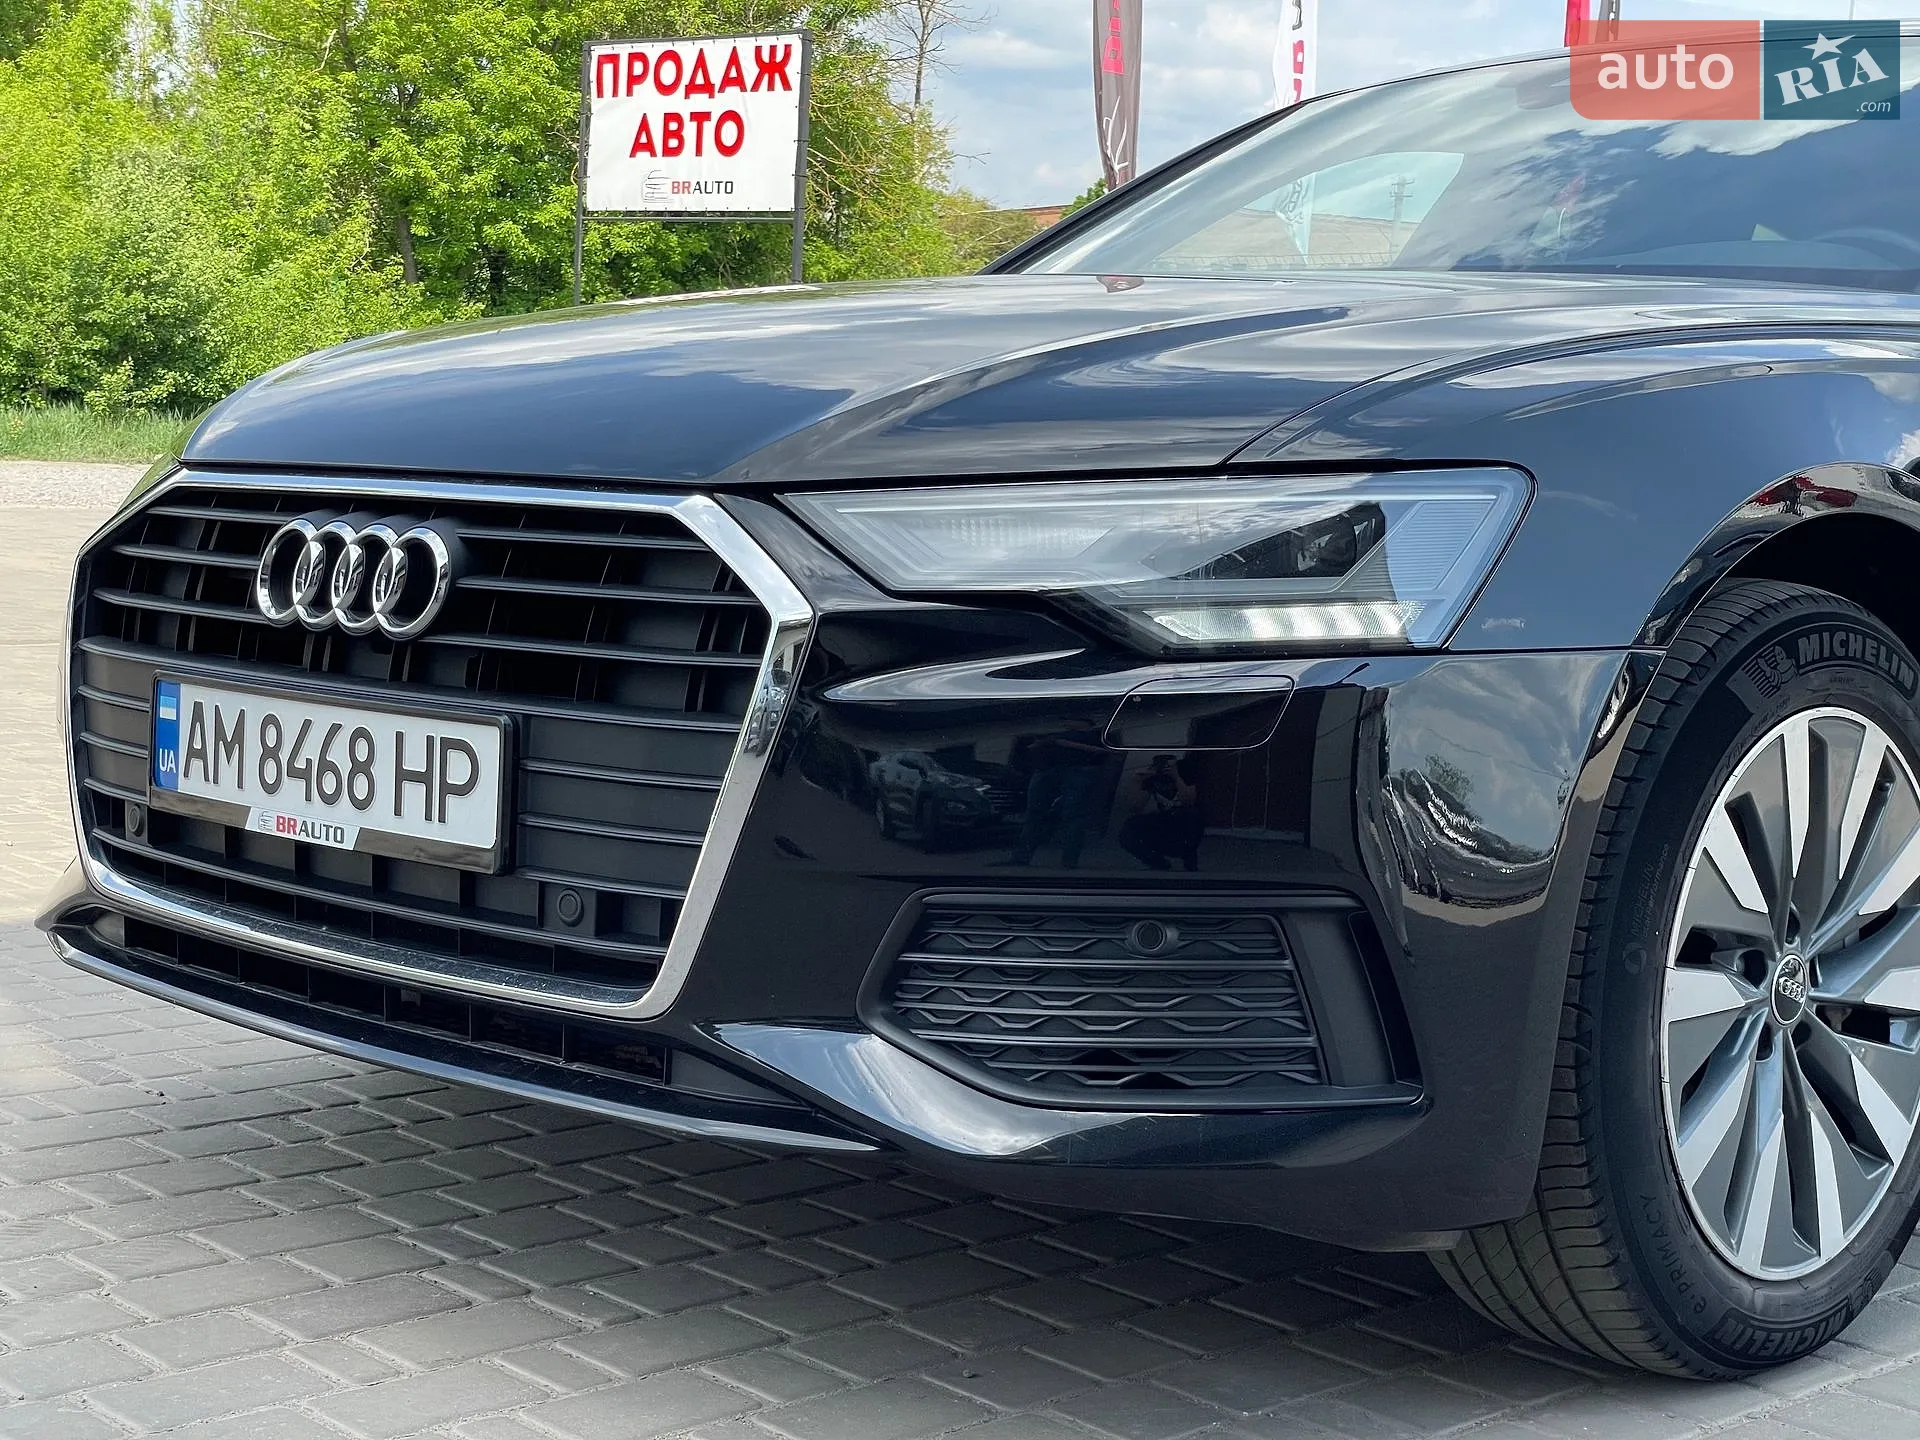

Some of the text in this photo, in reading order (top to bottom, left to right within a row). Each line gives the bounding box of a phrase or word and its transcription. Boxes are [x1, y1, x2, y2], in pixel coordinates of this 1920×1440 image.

[596, 44, 792, 99] ПРОДАЖ
[629, 110, 745, 158] АВТО
[671, 180, 734, 195] BRAUTO
[1797, 631, 1915, 690] MICHELIN
[158, 748, 176, 774] UA
[183, 701, 480, 824] AM 8468 HP
[276, 815, 345, 844] BRAUTO
[1713, 1310, 1847, 1357] MICHELIN
